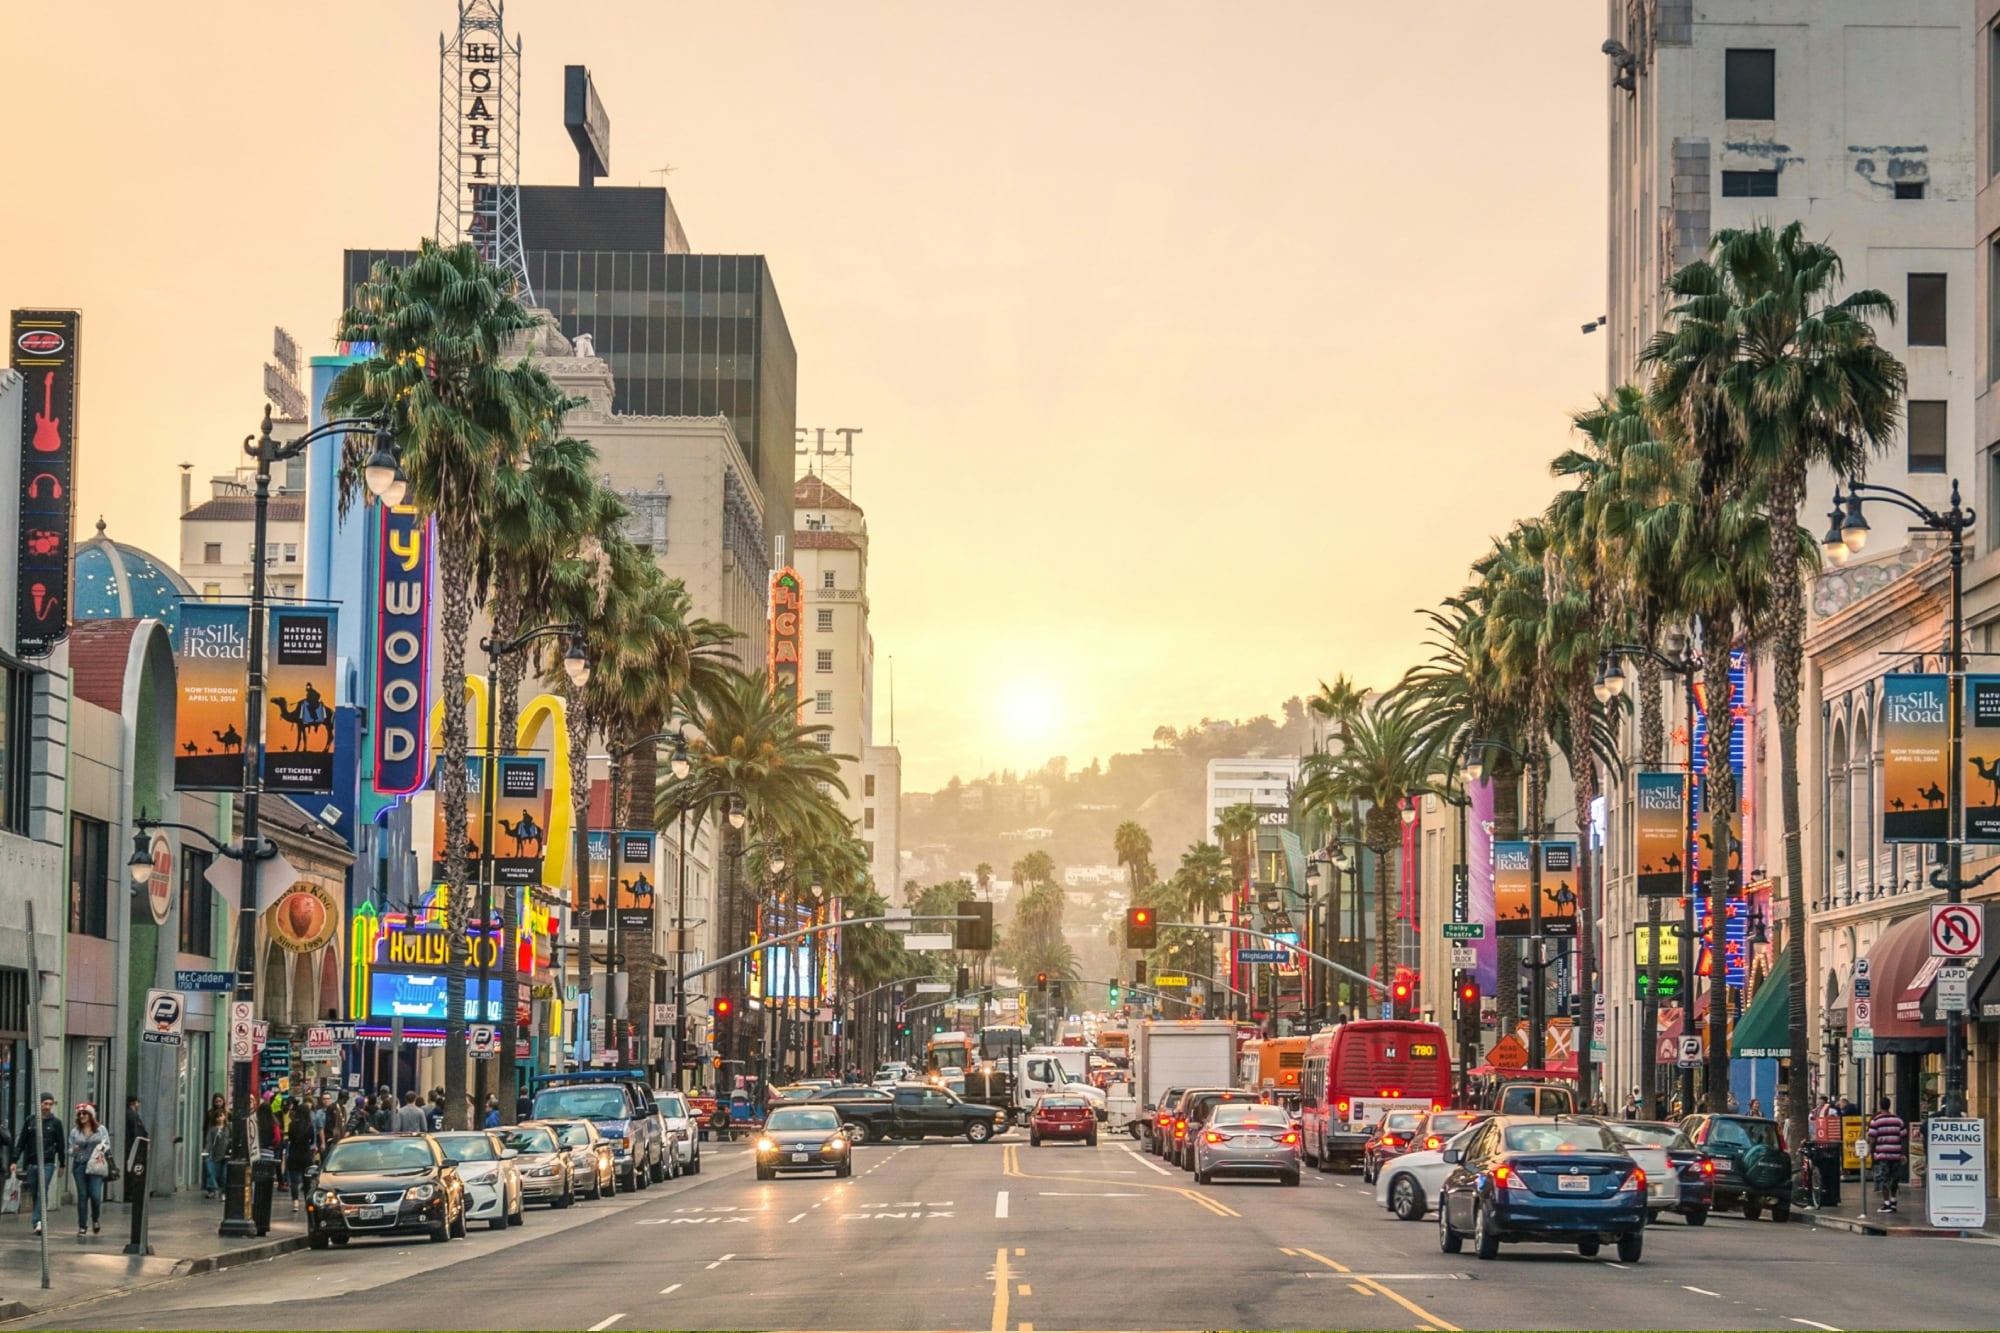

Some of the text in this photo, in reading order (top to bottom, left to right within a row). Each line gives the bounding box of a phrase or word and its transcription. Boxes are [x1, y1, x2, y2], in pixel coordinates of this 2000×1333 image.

[205, 623, 240, 644] Silk
[190, 636, 244, 659] Road
[1907, 691, 1939, 710] Silk
[1894, 703, 1944, 723] Road
[1655, 786, 1677, 800] Silk
[1645, 794, 1681, 809] Road
[1508, 852, 1526, 862] Silk
[1501, 858, 1528, 870] Road
[1242, 952, 1272, 960] Highland
[178, 972, 224, 983] McCadden
[1938, 970, 1966, 978] LAPD
[160, 1036, 180, 1044] HERE
[310, 1030, 332, 1042] ATM
[1386, 1048, 1396, 1058] M
[1414, 1045, 1433, 1056] 780
[1931, 1123, 1980, 1132] PUBLIC
[1931, 1134, 1981, 1142] PARKING
[1935, 1173, 1978, 1182] PARK LOCK WALK
